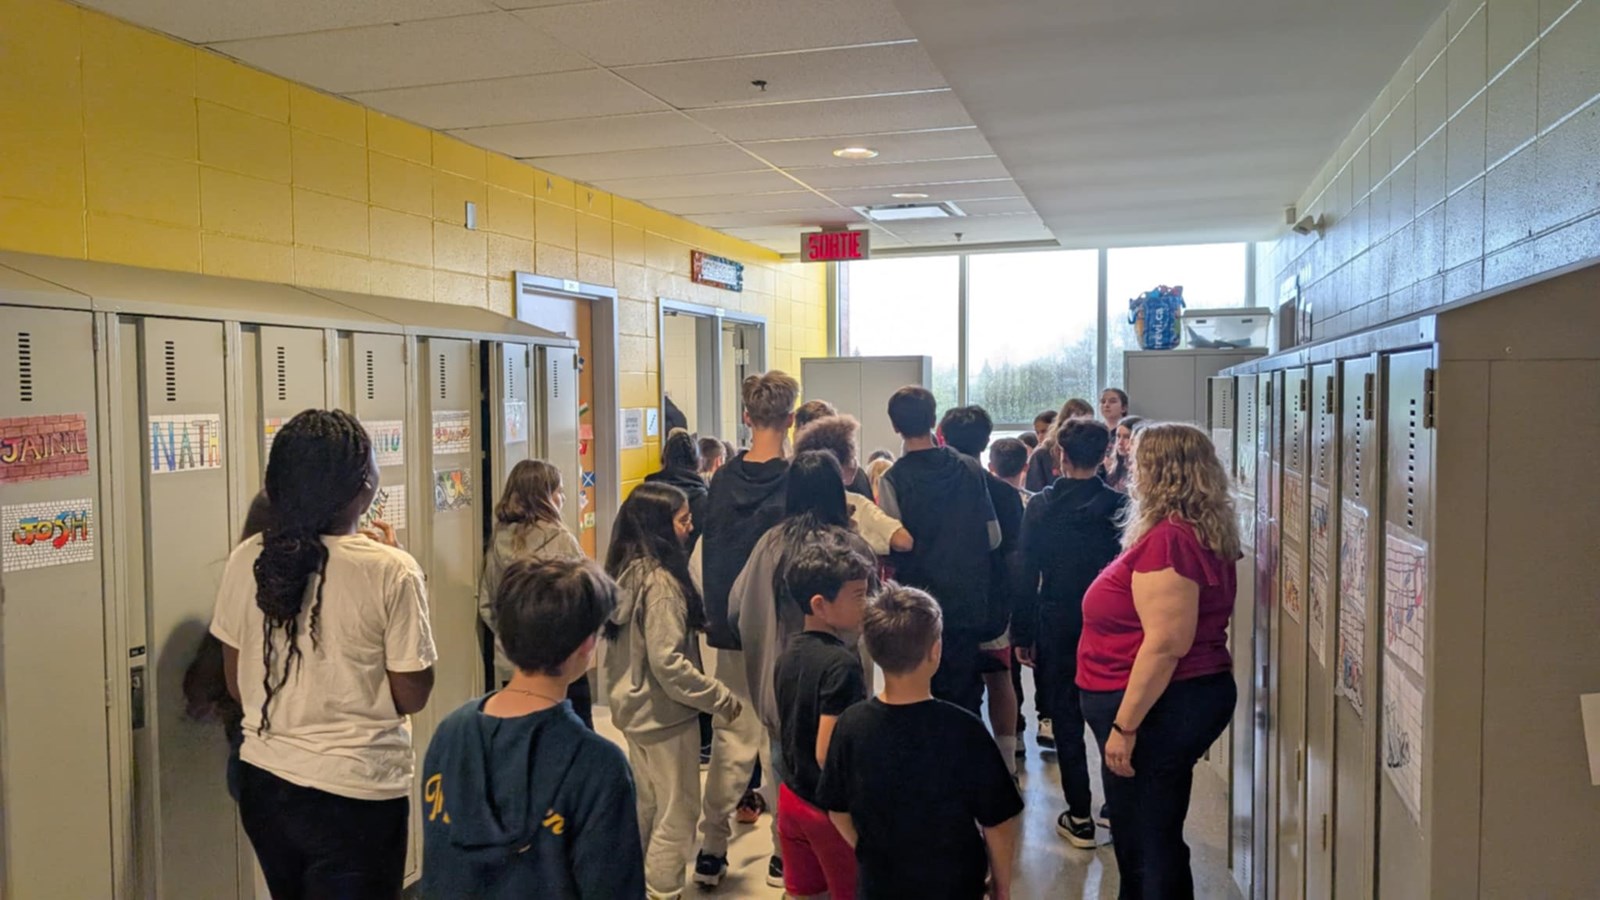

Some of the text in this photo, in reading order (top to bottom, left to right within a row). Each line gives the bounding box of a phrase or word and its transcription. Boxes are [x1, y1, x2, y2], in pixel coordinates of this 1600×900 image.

[808, 231, 863, 260] SORTIE
[152, 420, 220, 471] NATH
[12, 510, 88, 550] JOSH
